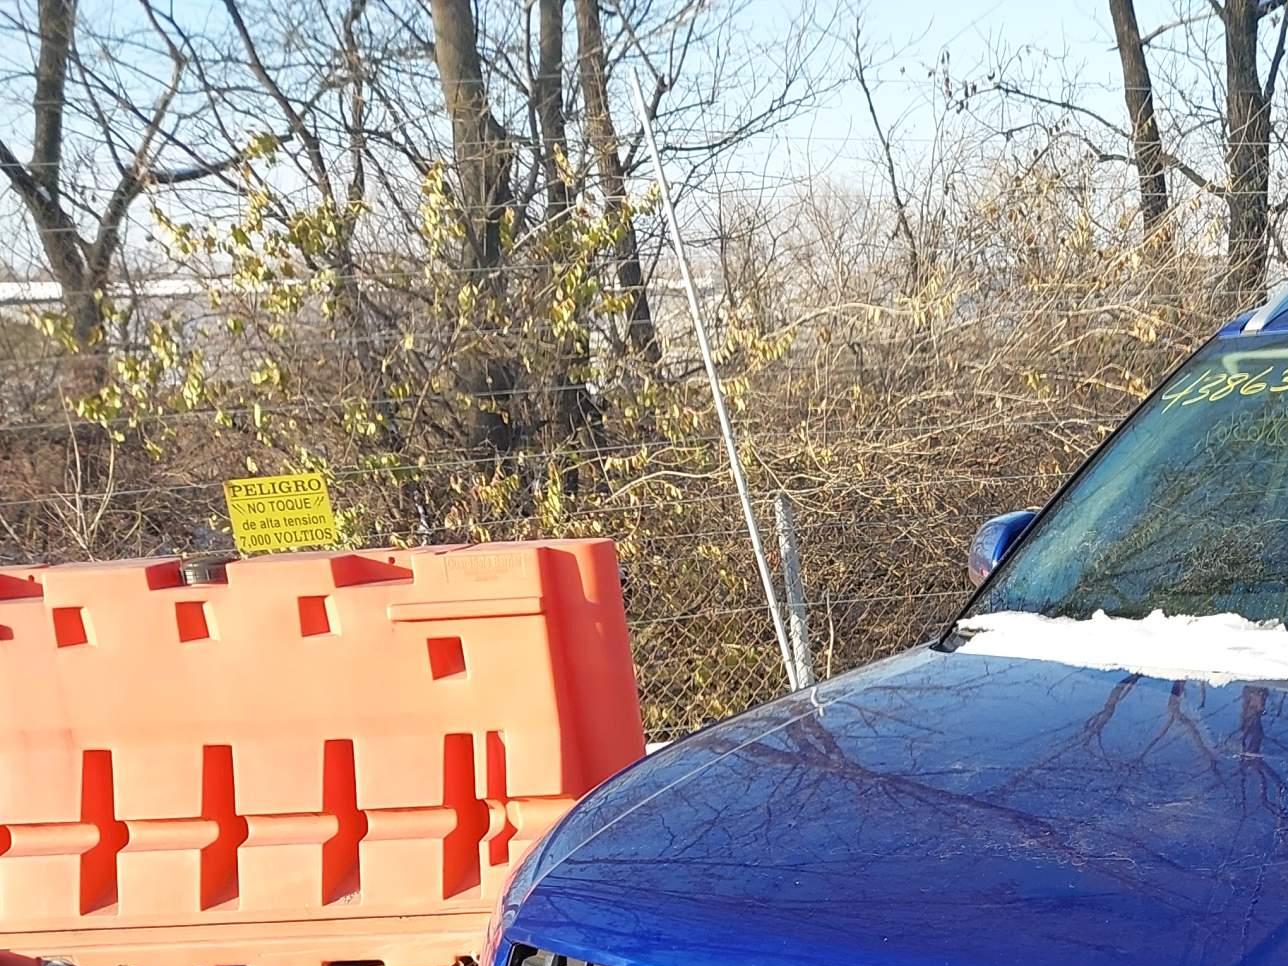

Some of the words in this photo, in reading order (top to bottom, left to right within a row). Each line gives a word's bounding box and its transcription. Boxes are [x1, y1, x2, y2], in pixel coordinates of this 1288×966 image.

[230, 478, 322, 498] PELIGRO
[247, 502, 266, 514] NO
[269, 498, 312, 512] TOQUE
[242, 519, 256, 531] de
[260, 517, 281, 529] alta
[284, 514, 326, 527] tension
[240, 533, 271, 548] 7,000
[273, 528, 333, 544] VOLTIOS
